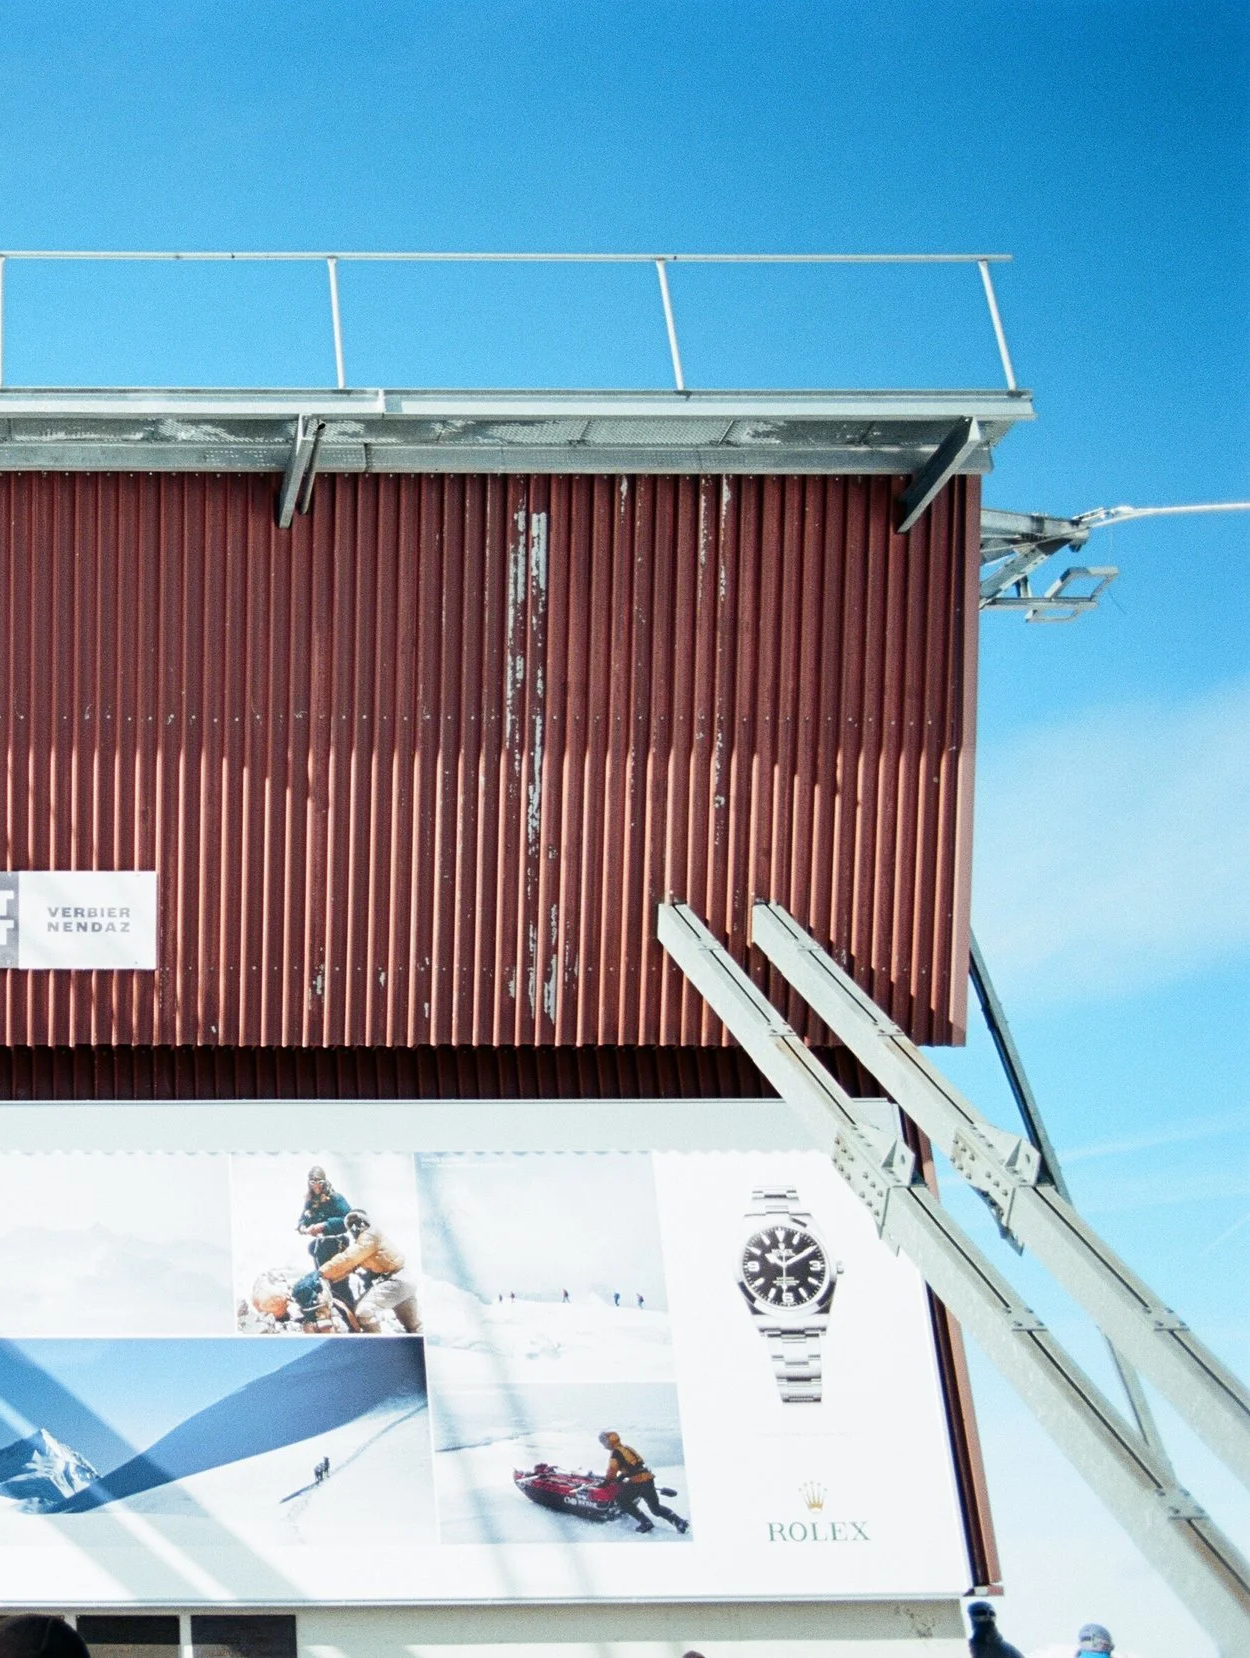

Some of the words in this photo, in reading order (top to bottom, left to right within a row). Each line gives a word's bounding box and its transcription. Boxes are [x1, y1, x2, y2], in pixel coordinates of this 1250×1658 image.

[47, 906, 131, 919] VERBIER
[47, 921, 131, 934] NENDAZ
[767, 1521, 871, 1543] ROLEX
